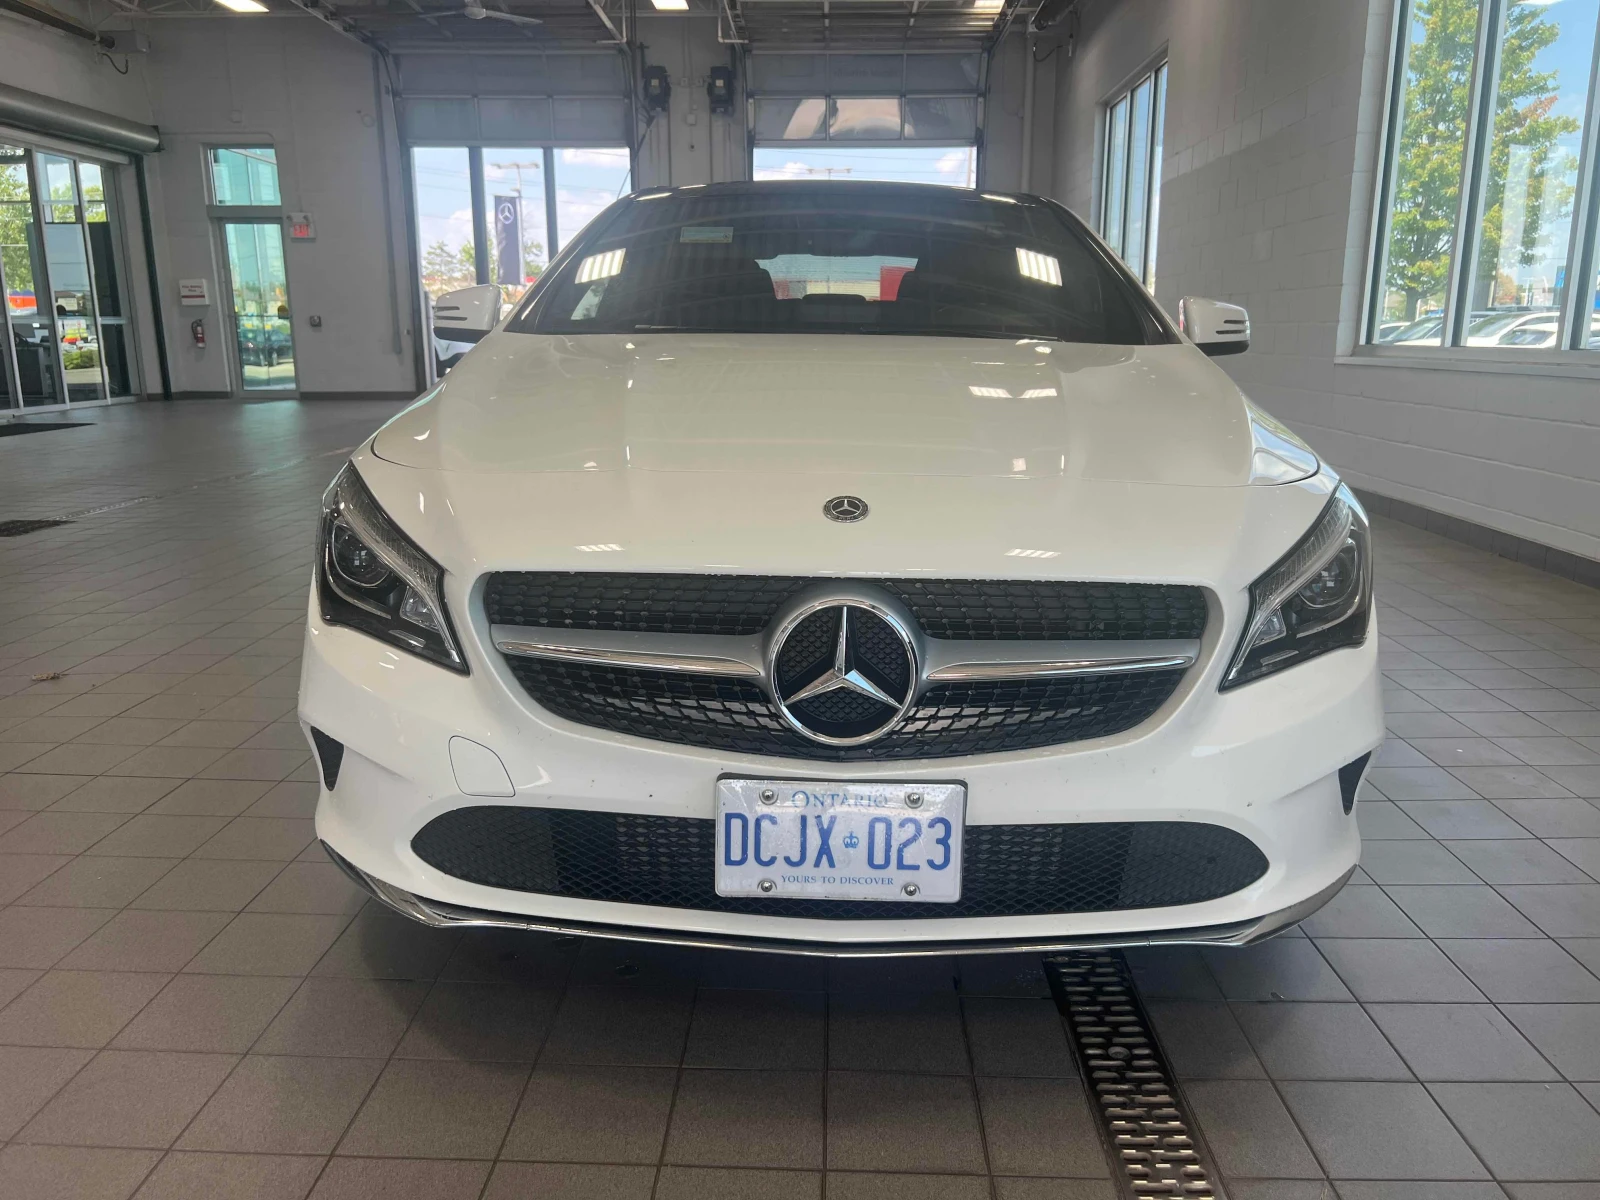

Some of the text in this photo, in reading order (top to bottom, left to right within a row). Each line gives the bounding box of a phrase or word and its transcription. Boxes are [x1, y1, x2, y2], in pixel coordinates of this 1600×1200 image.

[791, 790, 888, 808] ONTARIO
[724, 812, 952, 871] DCJX 023
[781, 875, 894, 886] YOURS TO DISCOVER
